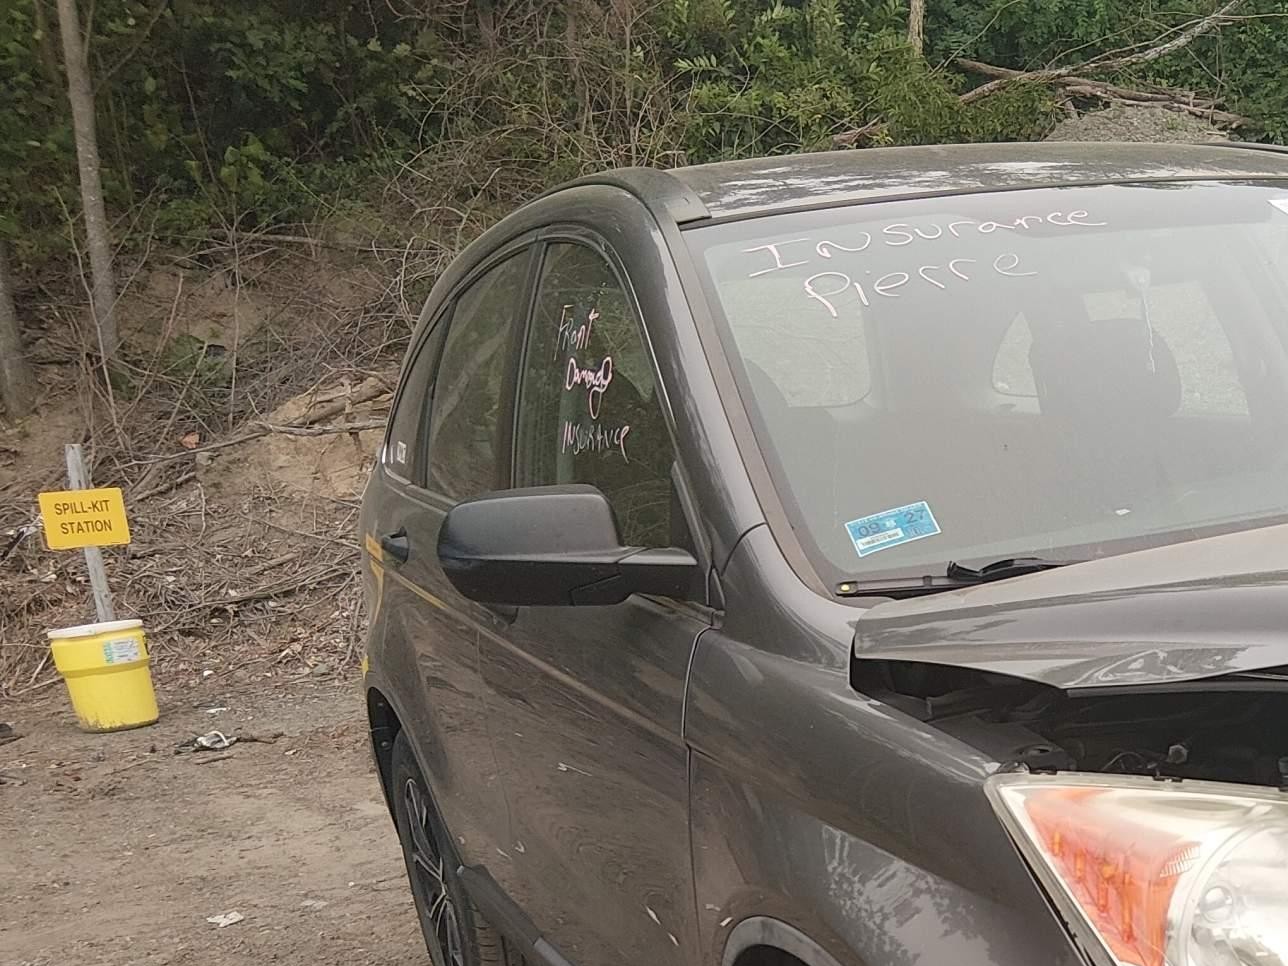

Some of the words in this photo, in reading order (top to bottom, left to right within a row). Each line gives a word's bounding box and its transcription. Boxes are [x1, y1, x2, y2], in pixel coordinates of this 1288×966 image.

[803, 253, 1039, 319] Pierre
[54, 499, 110, 516] SPILL-KIT
[60, 519, 113, 535] STATION
